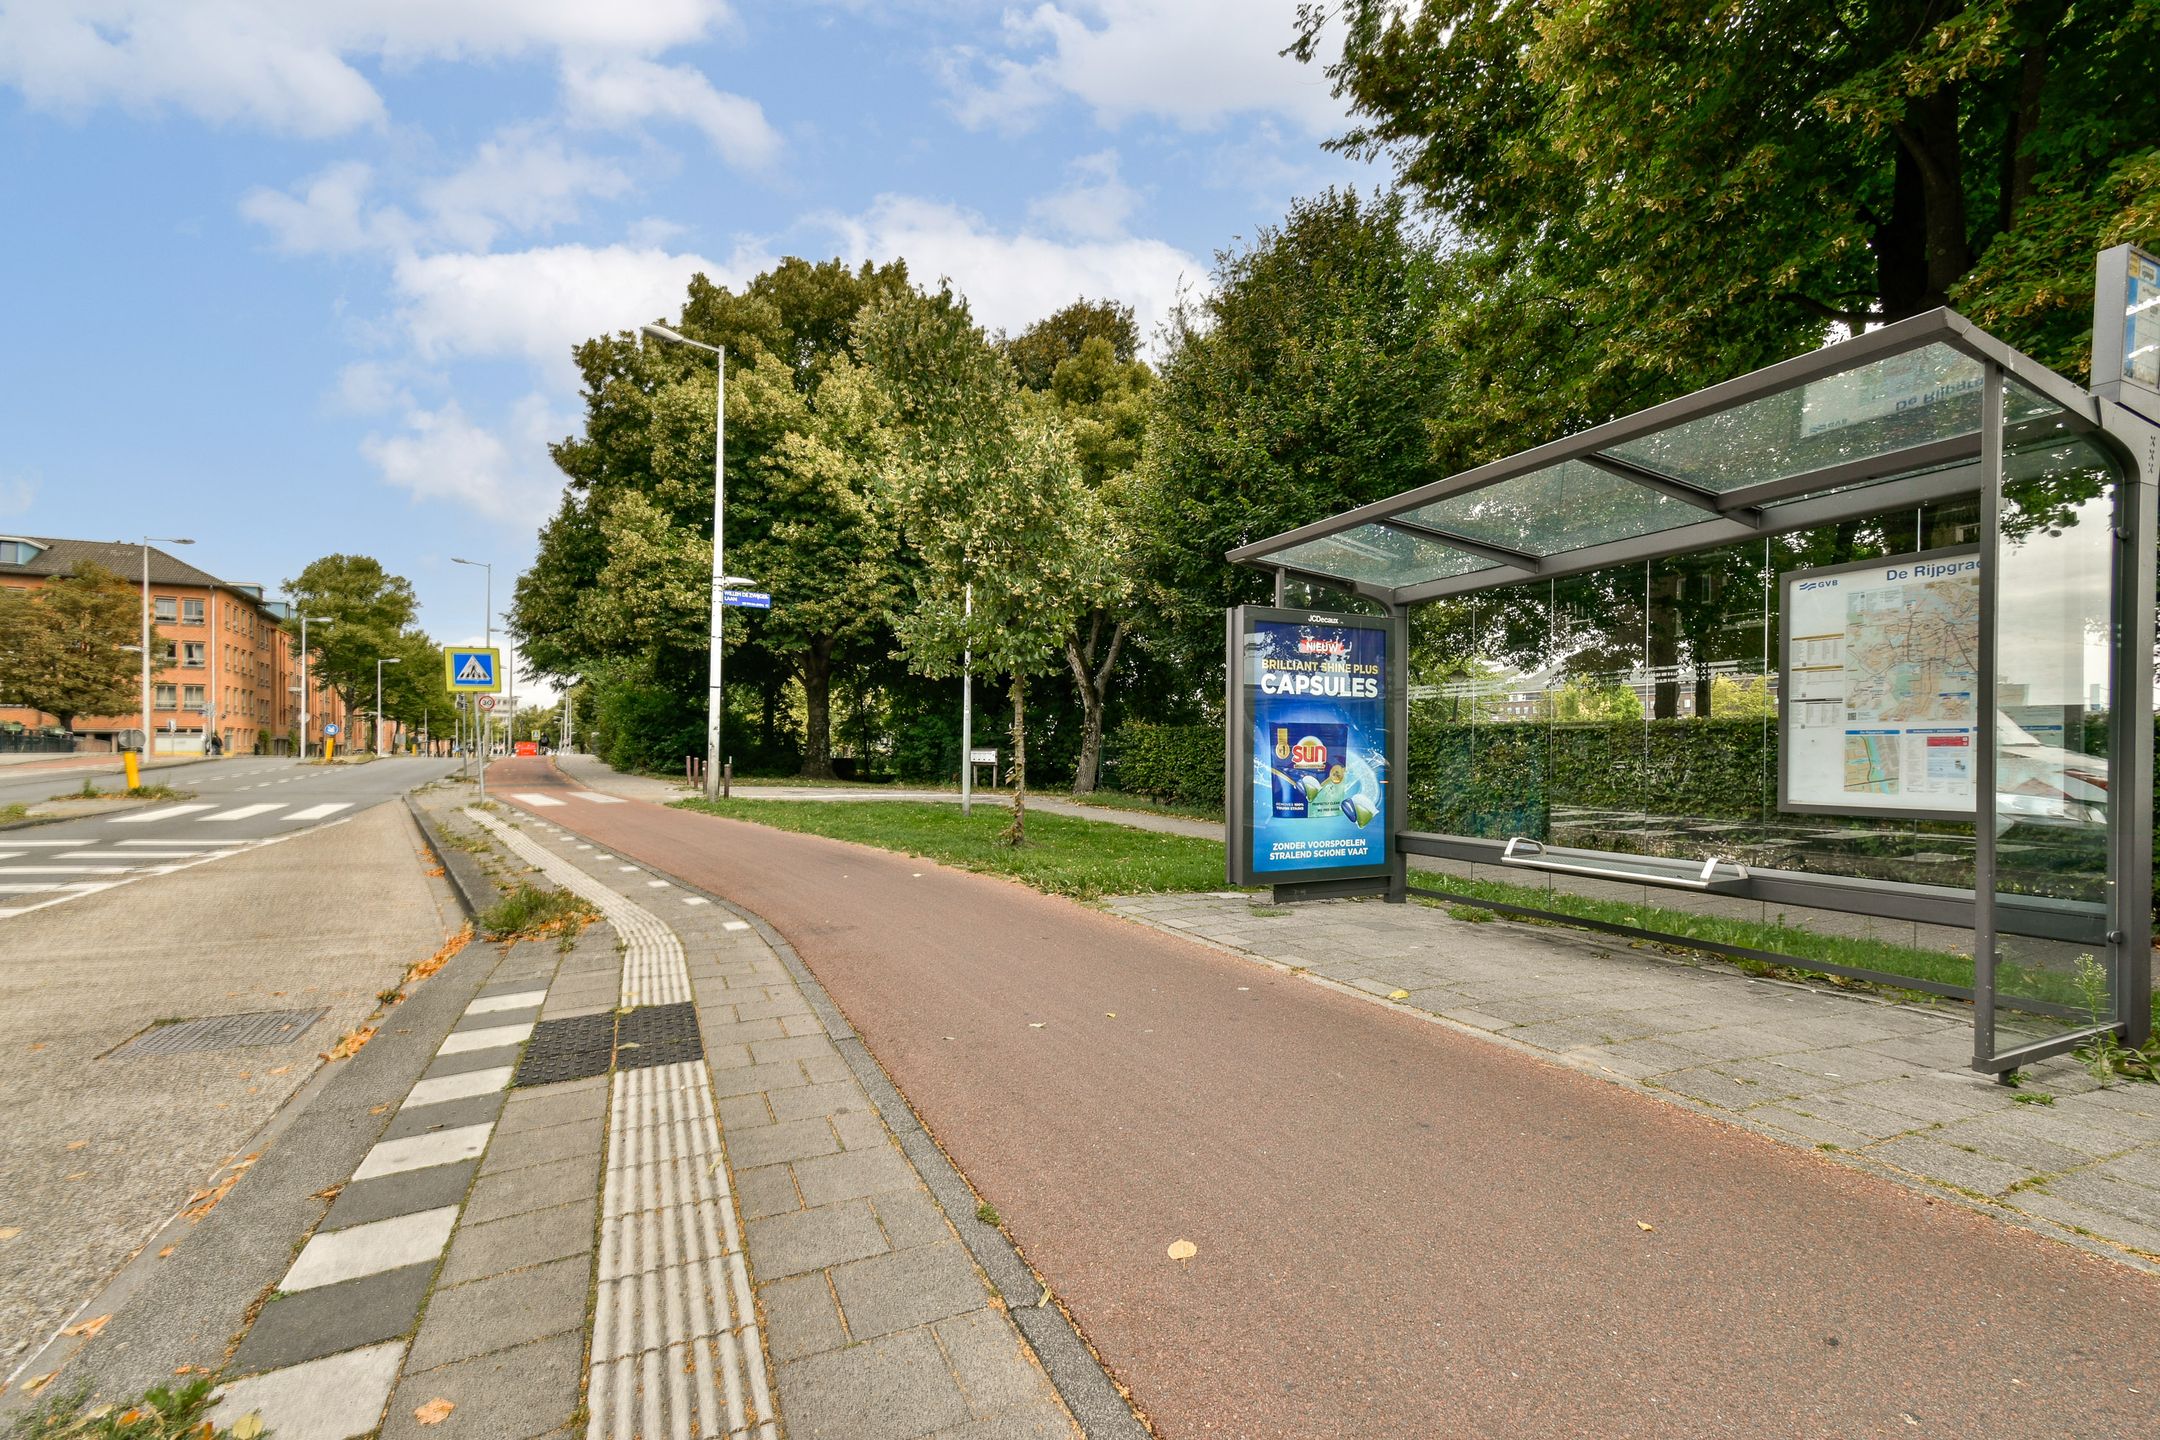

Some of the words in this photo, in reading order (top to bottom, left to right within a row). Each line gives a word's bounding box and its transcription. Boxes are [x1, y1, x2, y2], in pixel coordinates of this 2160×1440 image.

[1886, 569, 1908, 581] De
[1817, 579, 1838, 589] GVB
[1308, 614, 1338, 624] JCDecaux
[1306, 641, 1338, 652] NIEUW
[1261, 658, 1318, 672] BRILLIANT
[1321, 662, 1351, 673] SHINE
[1353, 664, 1379, 675] PLUS
[1260, 673, 1378, 698] CAPSULES
[1272, 841, 1306, 851] ZONDER
[1307, 838, 1366, 849] VOORSPOELEN
[1269, 850, 1312, 860] STRALEND
[1313, 848, 1346, 858] SCHONE
[1347, 847, 1369, 856] VAAT
